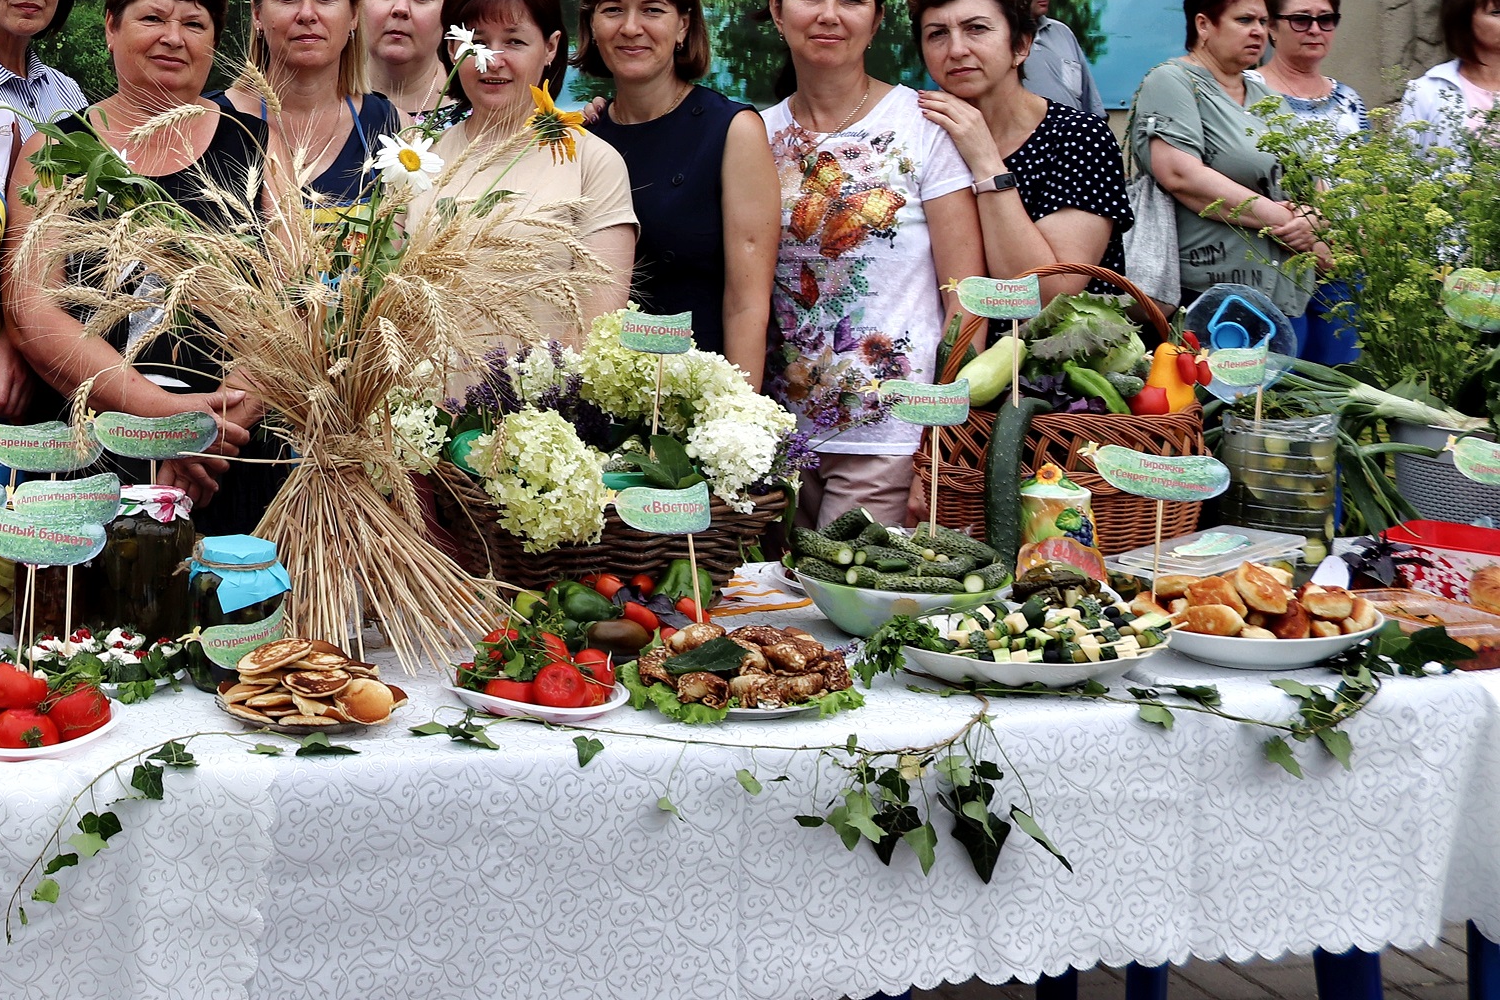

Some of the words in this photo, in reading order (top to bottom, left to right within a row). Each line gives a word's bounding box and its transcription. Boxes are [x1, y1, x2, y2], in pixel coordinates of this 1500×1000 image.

[995, 283, 1030, 294] Огурец
[108, 427, 199, 441] «Похрустим?»
[1109, 468, 1150, 483] «Секрет
[16, 493, 76, 504] «Аппетитная
[642, 501, 705, 515] «Восторг»
[38, 527, 94, 547] бархат»
[208, 627, 270, 648] «Огуречный
